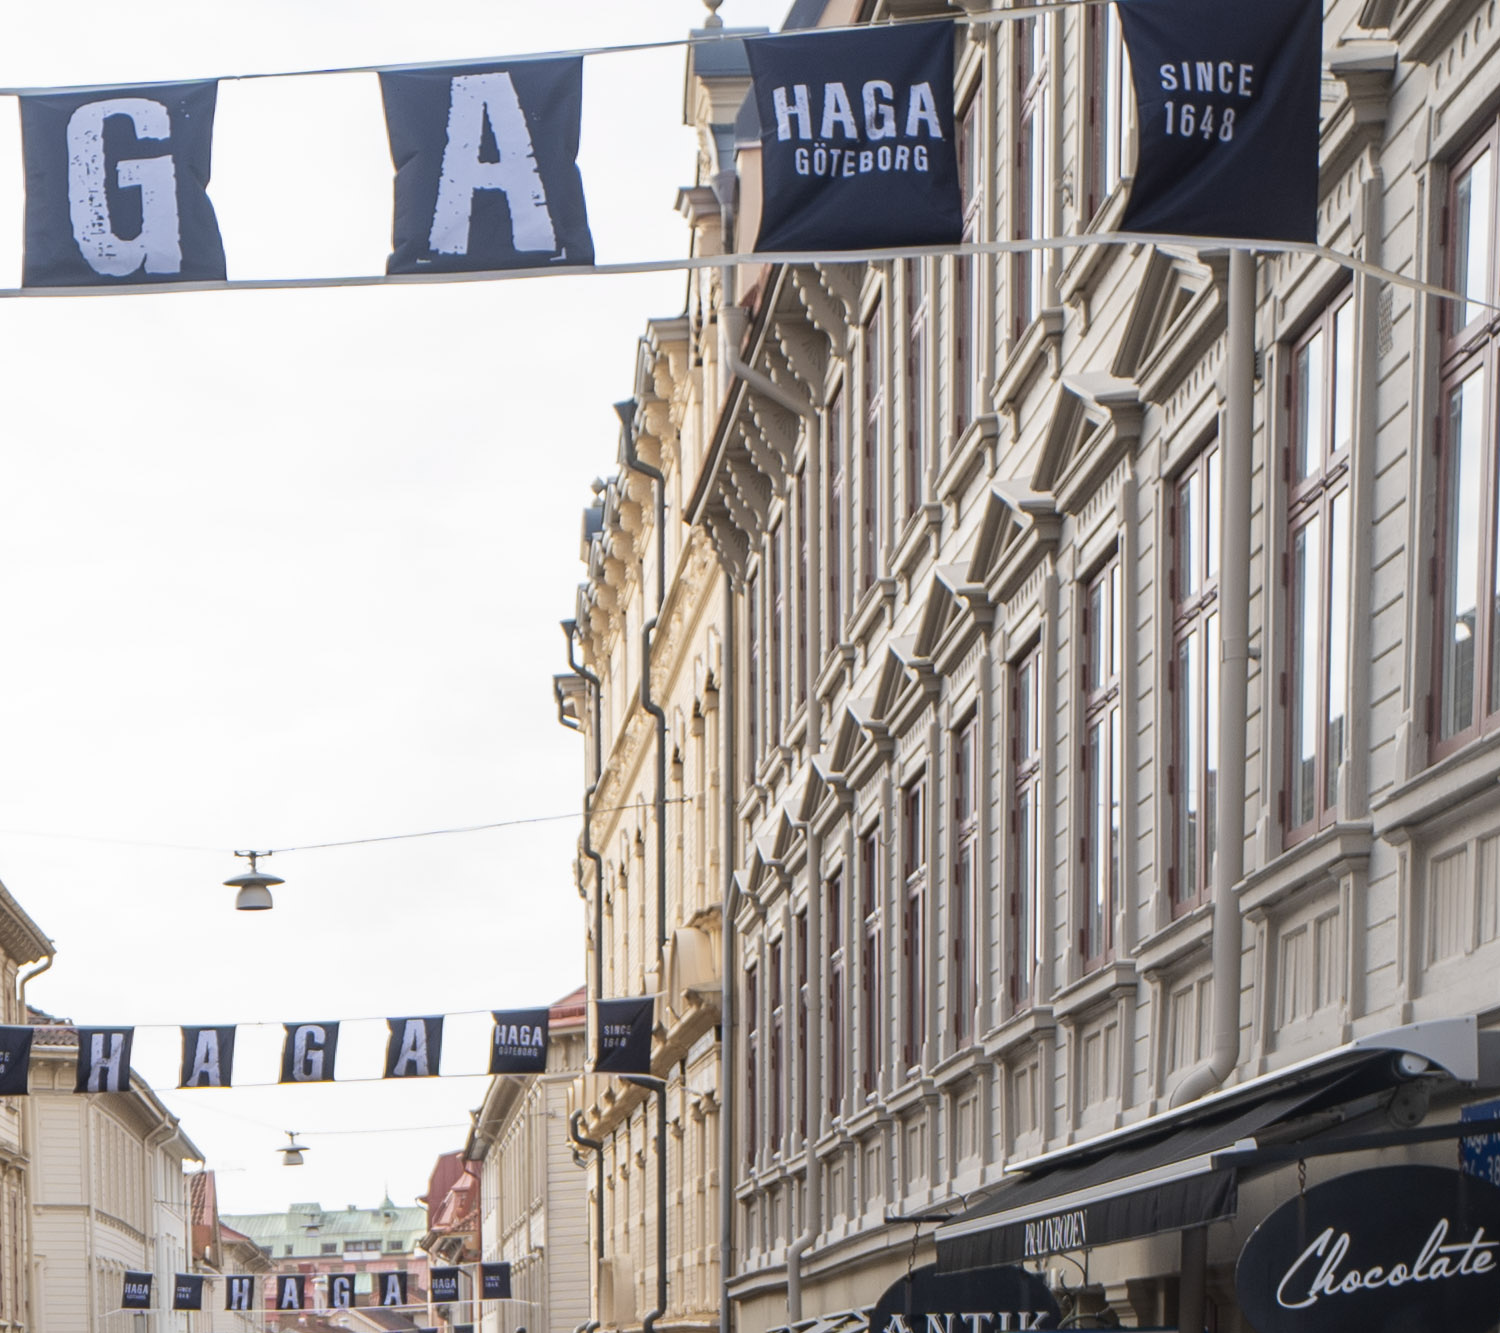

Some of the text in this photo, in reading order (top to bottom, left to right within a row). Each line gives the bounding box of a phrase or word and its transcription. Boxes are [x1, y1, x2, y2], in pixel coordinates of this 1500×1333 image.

[1160, 61, 1254, 97] SINCE
[772, 80, 944, 141] HAGA
[1163, 102, 1237, 142] 1648
[795, 143, 929, 177] GÖTEBORG
[495, 1024, 544, 1048] HAGA
[1024, 1208, 1088, 1257] PRALINBODEN
[1276, 1218, 1500, 1308] Chocolate
